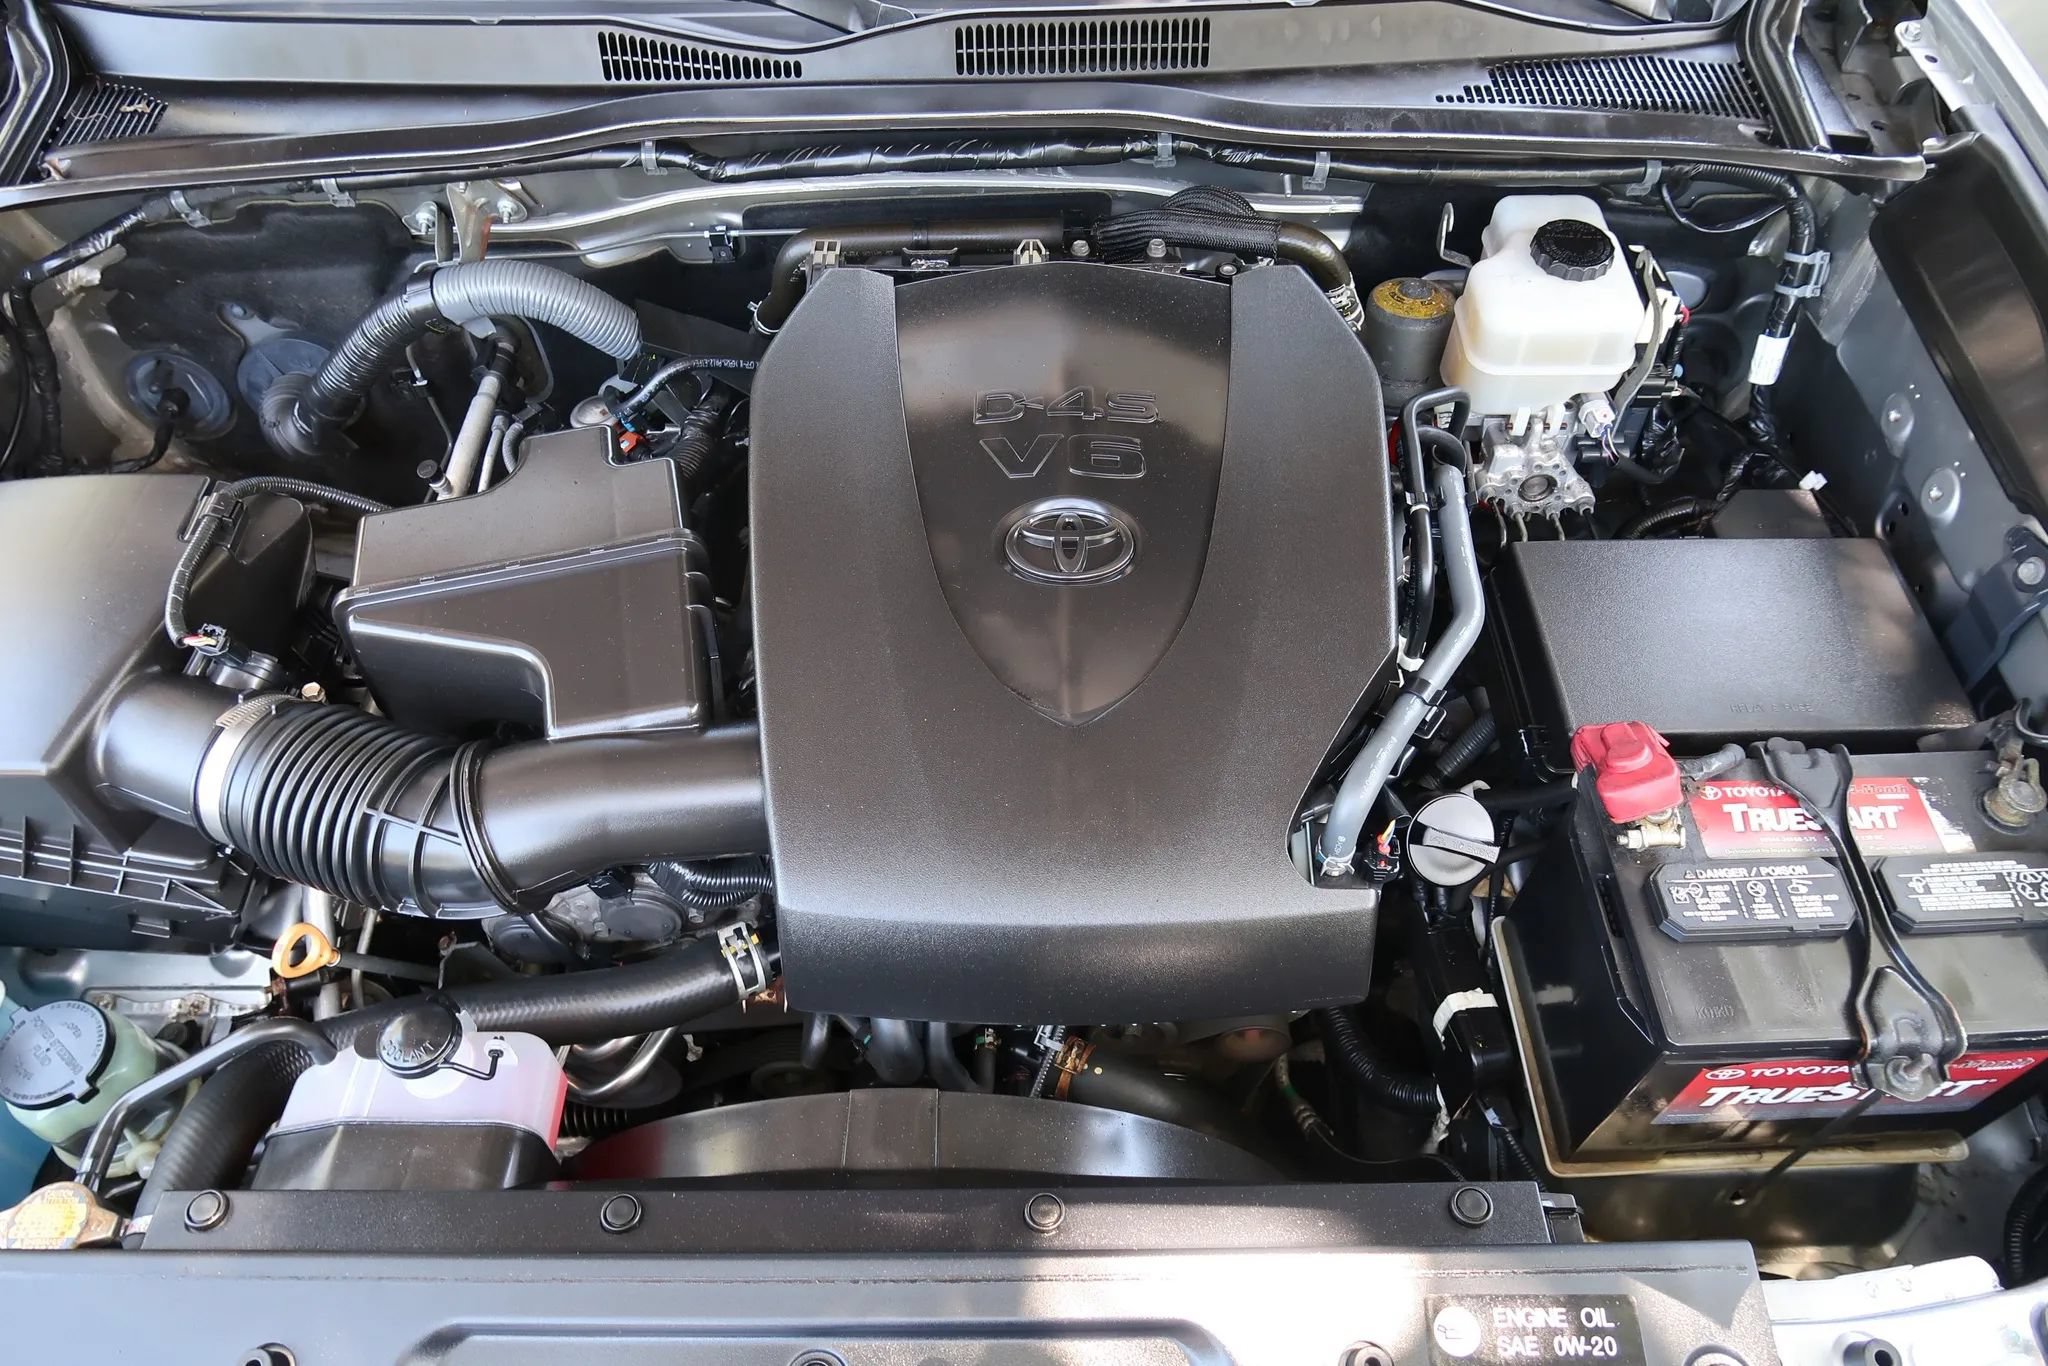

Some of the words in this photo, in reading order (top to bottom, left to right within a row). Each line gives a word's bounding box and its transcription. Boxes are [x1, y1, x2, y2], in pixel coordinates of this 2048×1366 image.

[973, 386, 1160, 424] D-4S
[979, 433, 1147, 479] V6
[1697, 866, 1749, 879] DANGER
[1760, 865, 1808, 877] POISON
[382, 1039, 435, 1063] COOLANT
[1751, 1065, 1850, 1078] TOYOTA
[1494, 1307, 1568, 1328] ENGINE
[1580, 1307, 1615, 1328] OIL
[1497, 1335, 1540, 1357] SAE
[1553, 1336, 1617, 1357] 0W-20
